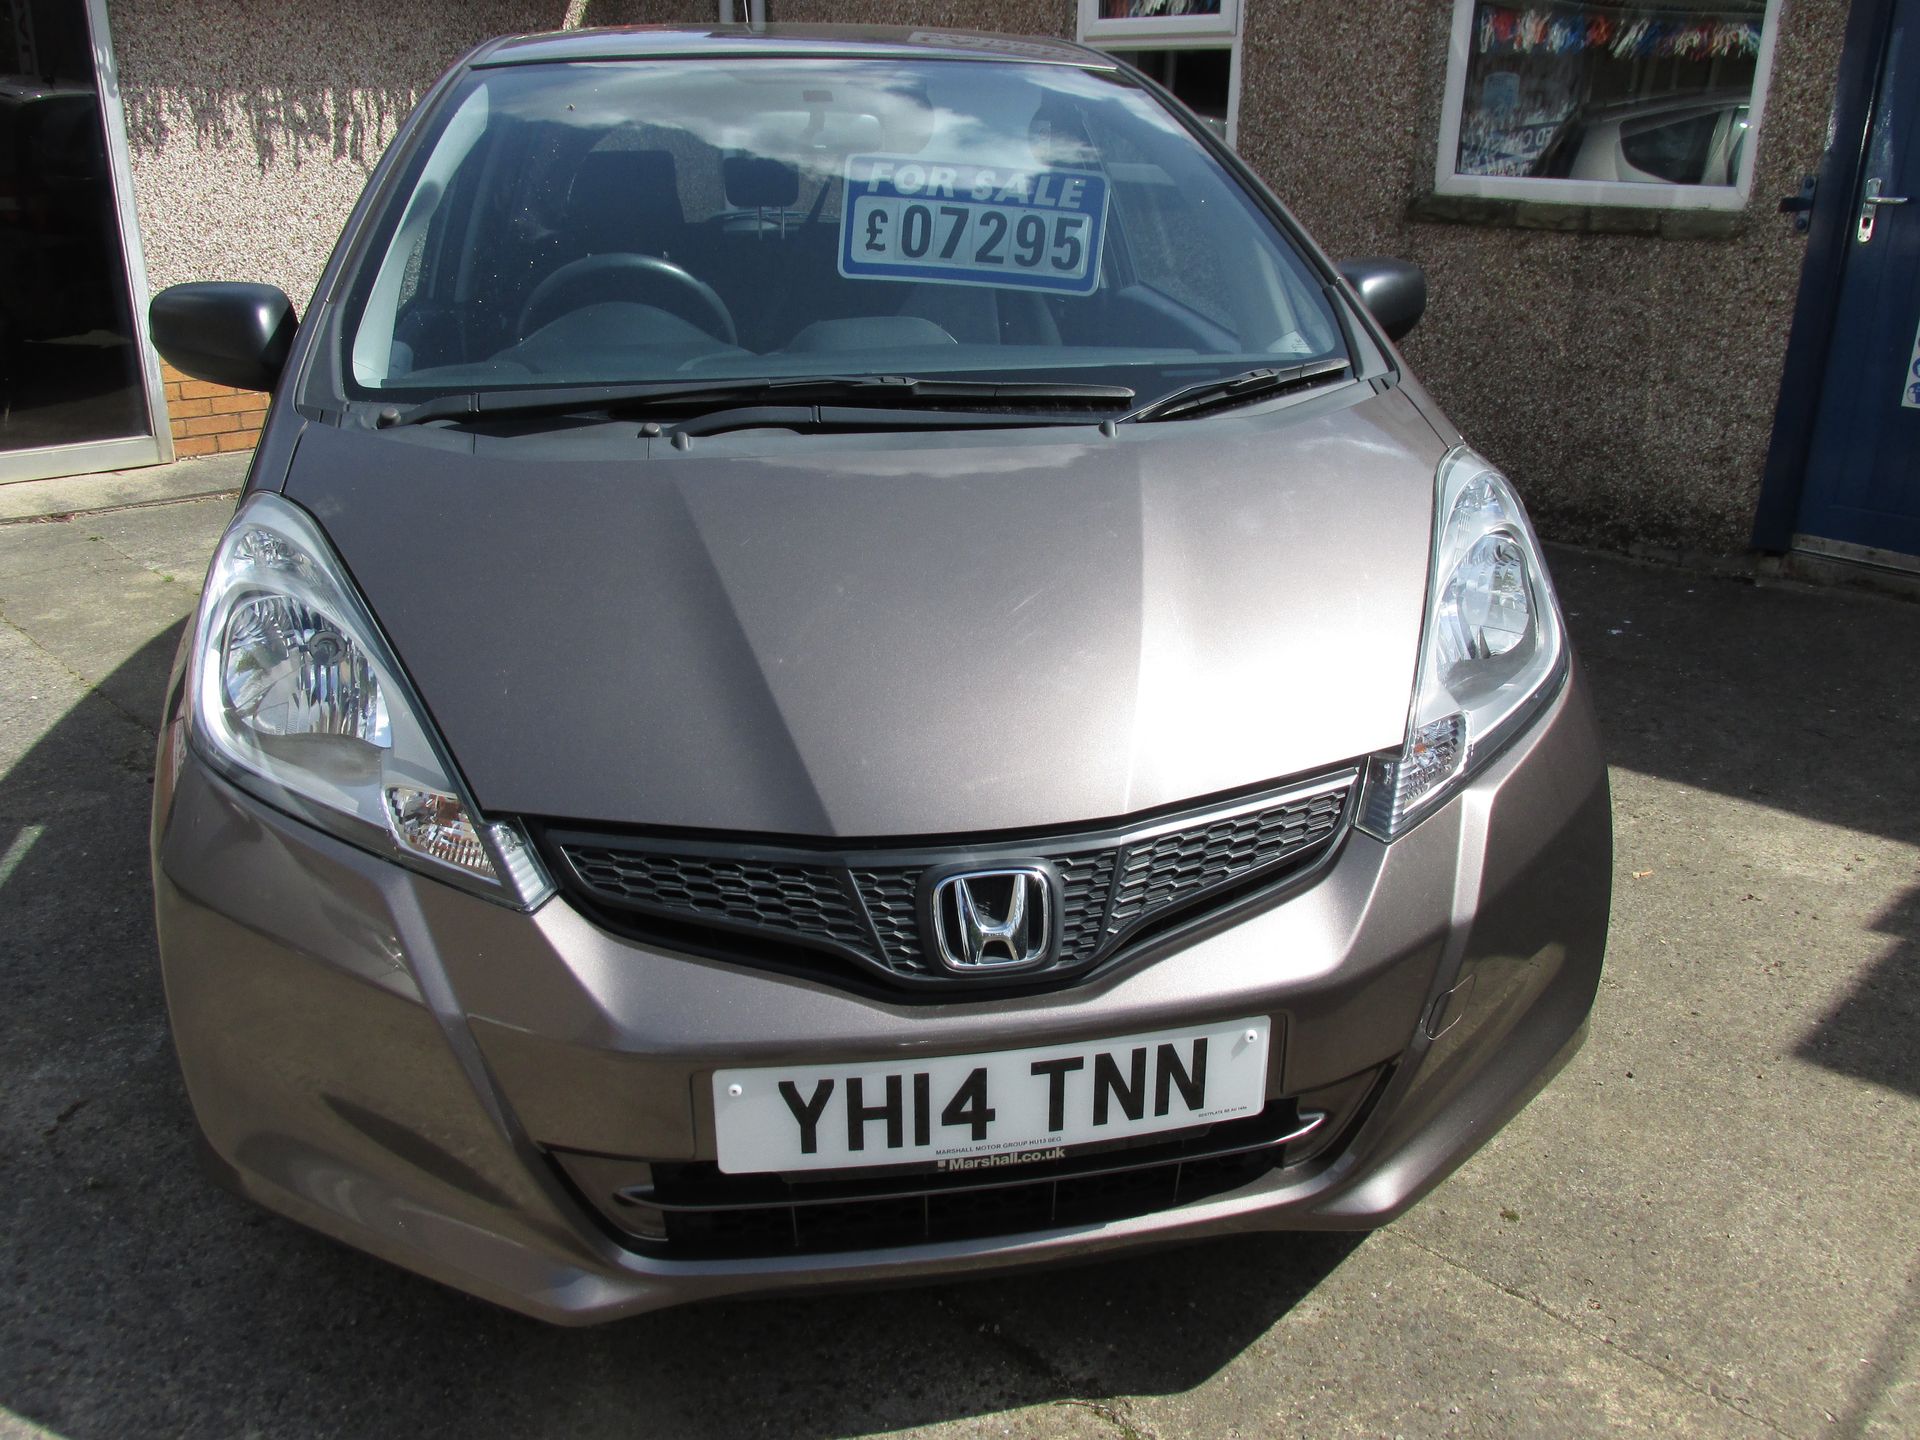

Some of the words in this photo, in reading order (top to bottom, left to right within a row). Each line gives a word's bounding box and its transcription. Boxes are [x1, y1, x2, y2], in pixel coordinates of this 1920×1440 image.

[867, 162, 957, 198] FOR
[971, 170, 1087, 209] SALE
[865, 204, 1084, 271] £07295
[778, 1067, 996, 1154] YH14
[1030, 1037, 1208, 1133] TNN
[936, 1147, 973, 1156] MARSHALL
[975, 1144, 1002, 1152] MOTOR
[1002, 1140, 1028, 1149] GROUP
[949, 1147, 1066, 1171] Marshall.co.uk
